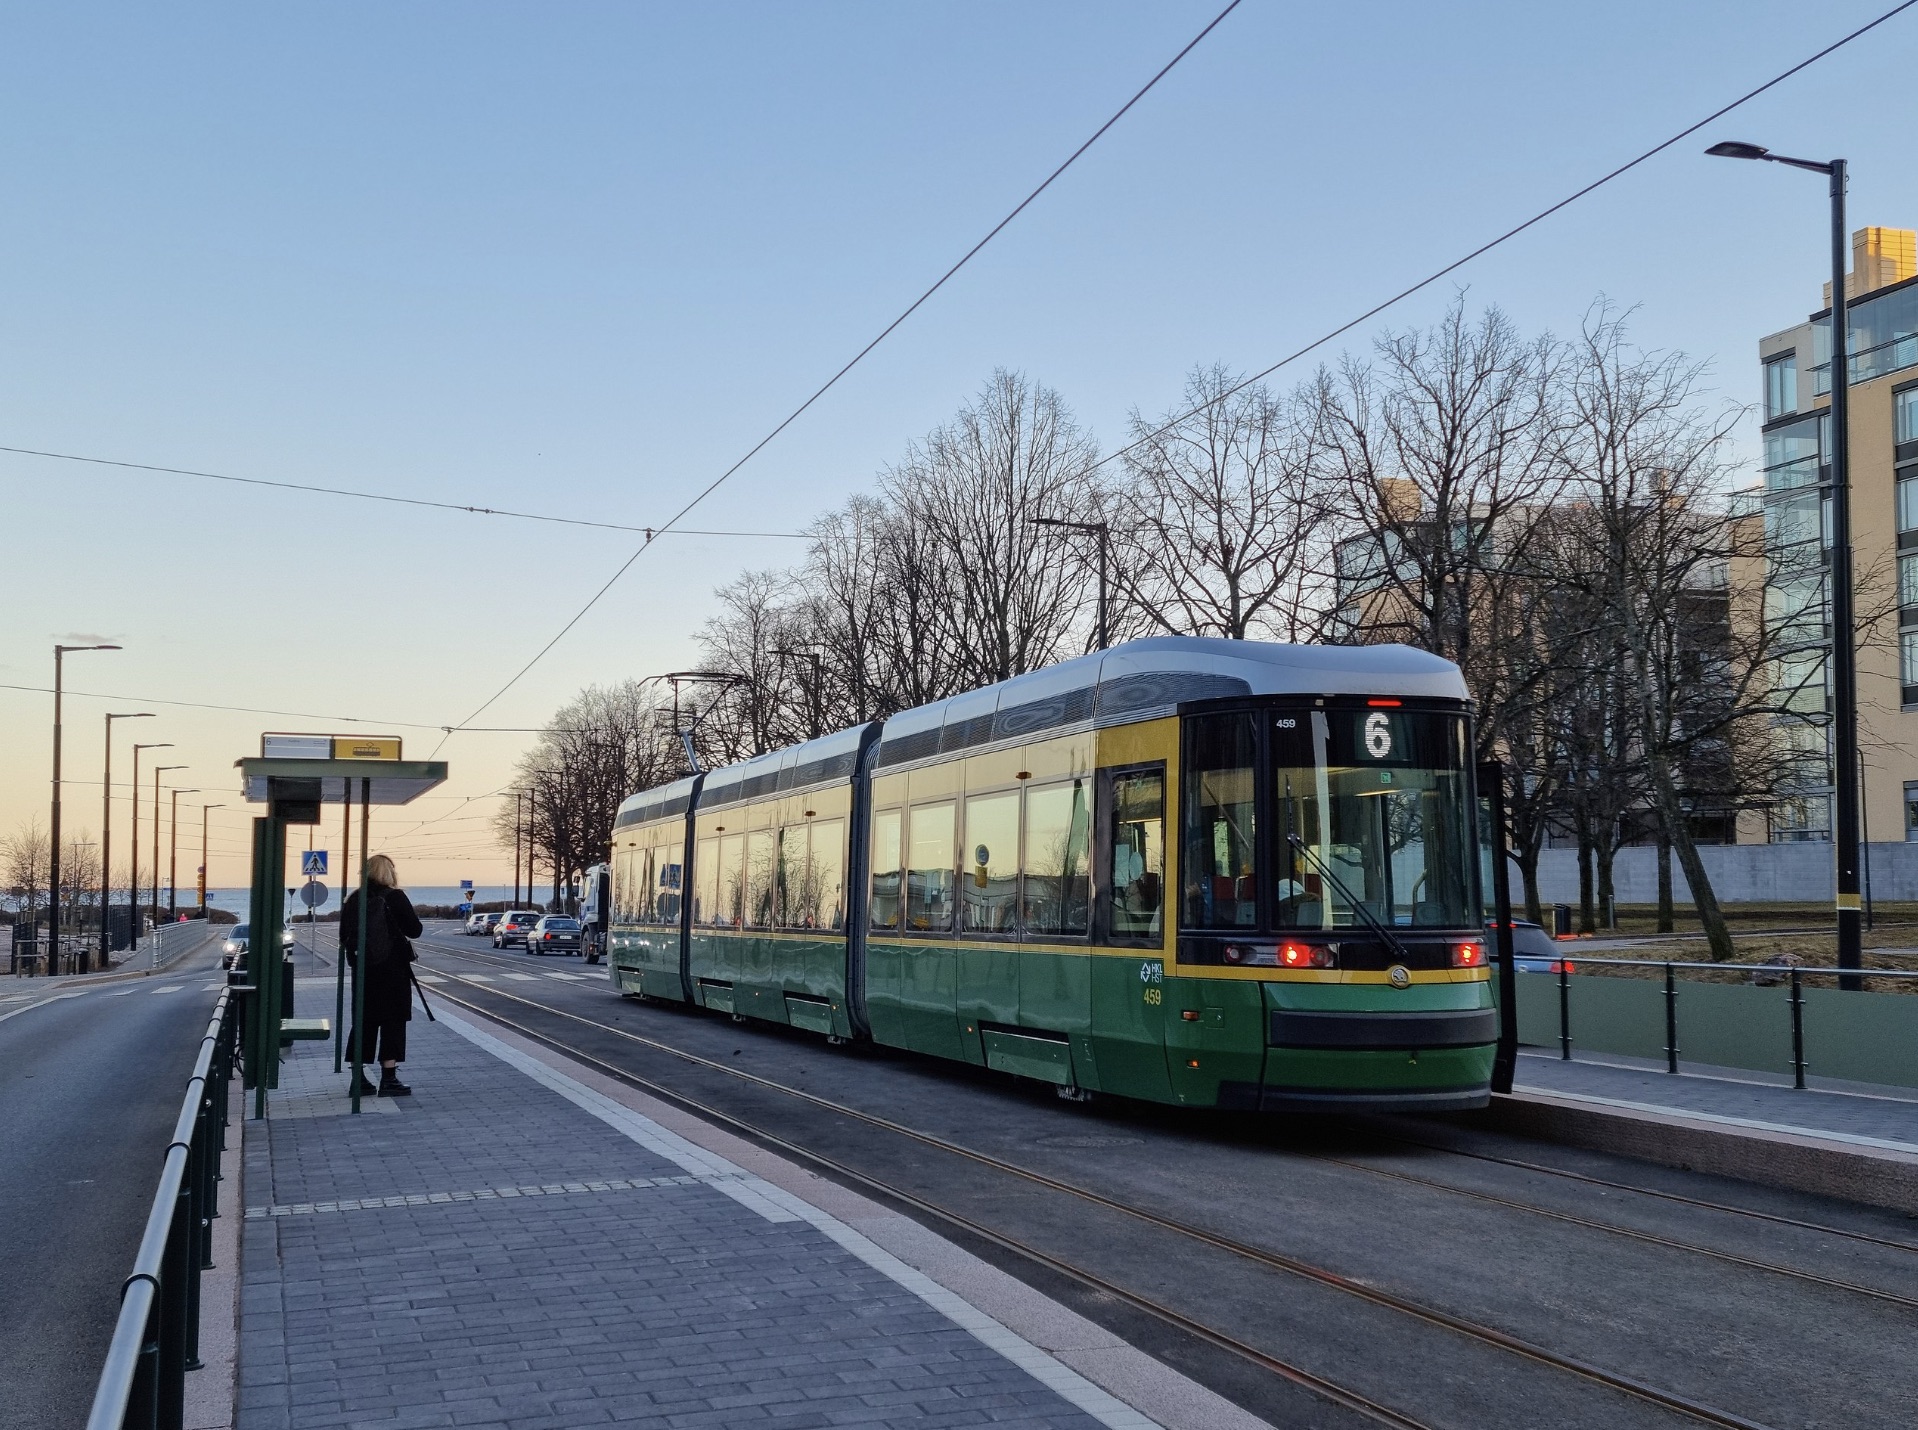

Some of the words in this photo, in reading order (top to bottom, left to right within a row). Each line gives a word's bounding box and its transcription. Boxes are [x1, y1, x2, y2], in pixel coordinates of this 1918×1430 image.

[1276, 719, 1296, 728] 459
[1365, 712, 1391, 758] 6
[266, 737, 272, 746] 6
[1151, 963, 1163, 974] HKL
[1151, 973, 1163, 983] HST
[1143, 988, 1162, 1005] 459
